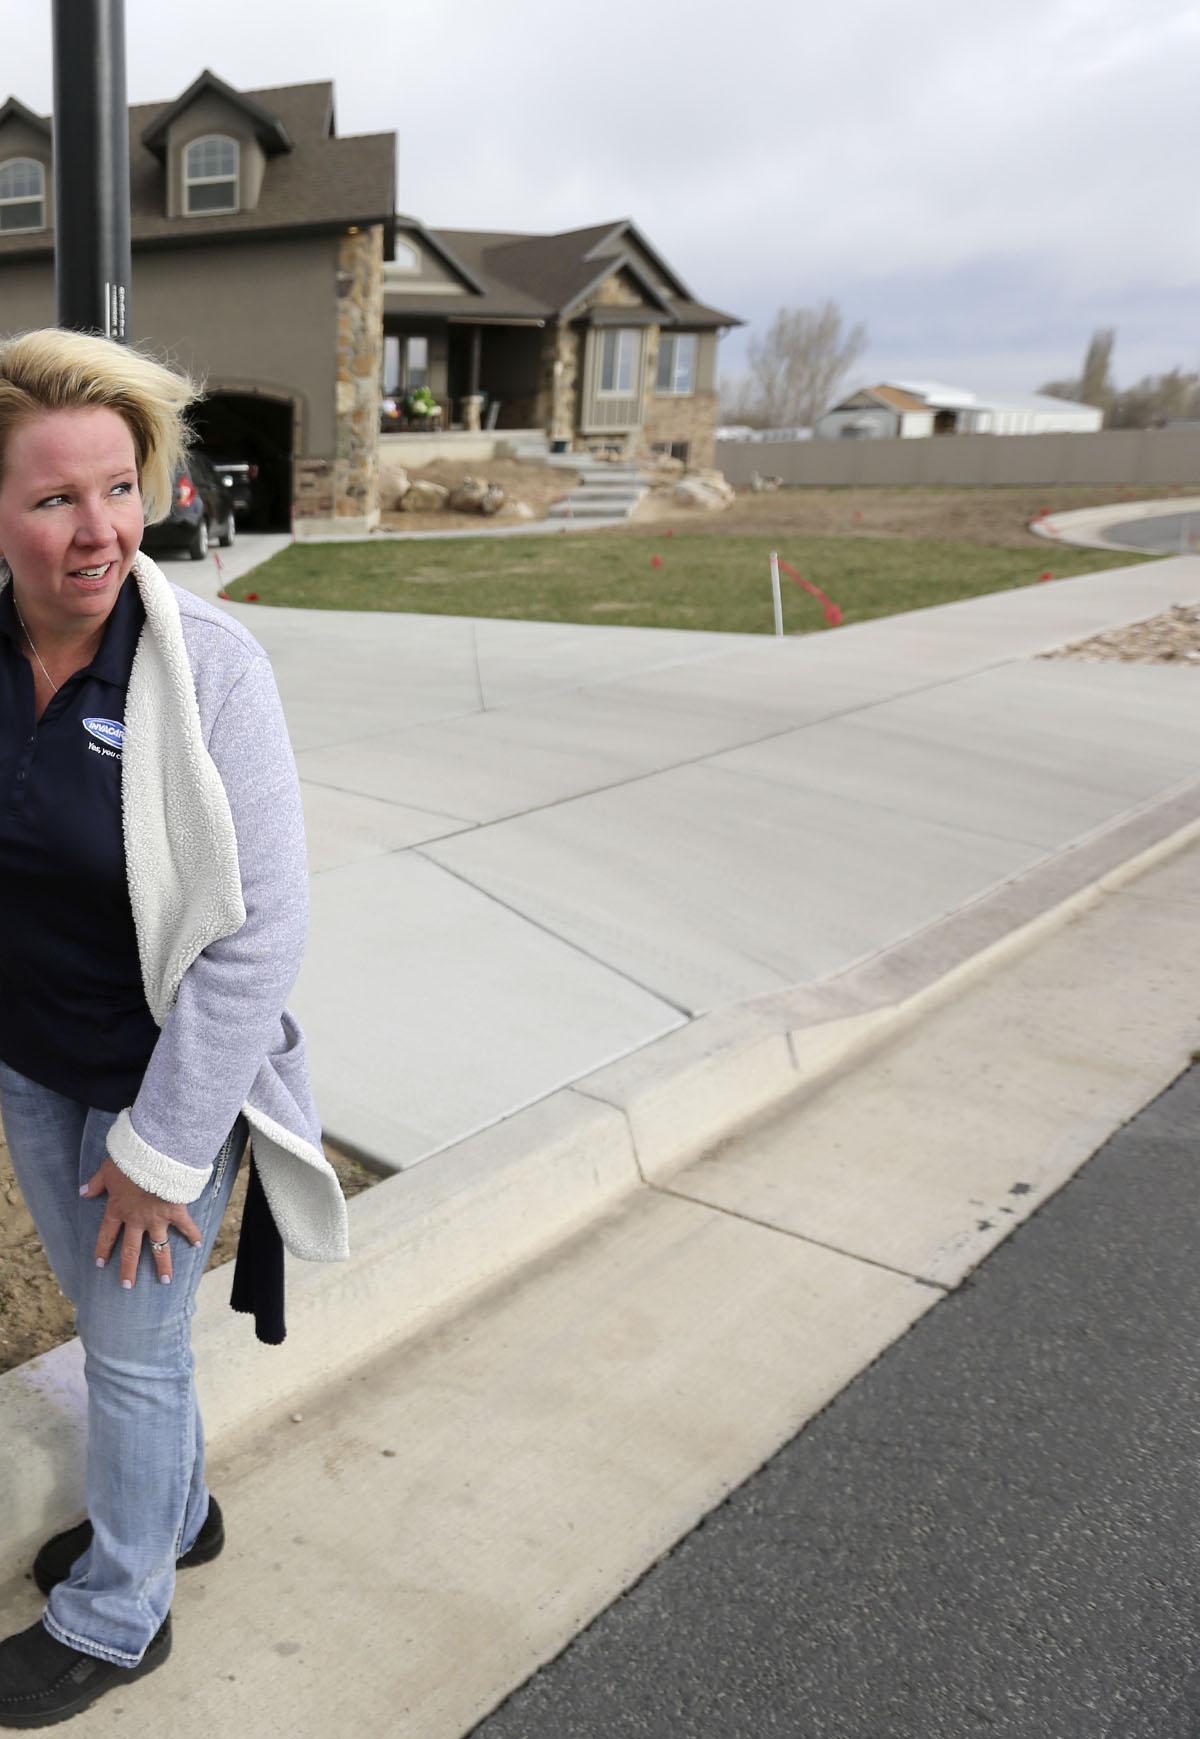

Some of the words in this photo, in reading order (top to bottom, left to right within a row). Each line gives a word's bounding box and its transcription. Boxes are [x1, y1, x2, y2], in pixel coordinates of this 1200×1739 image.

[88, 721, 126, 739] INVACAR
[88, 742, 101, 754] Yes,
[101, 748, 116, 758] you
